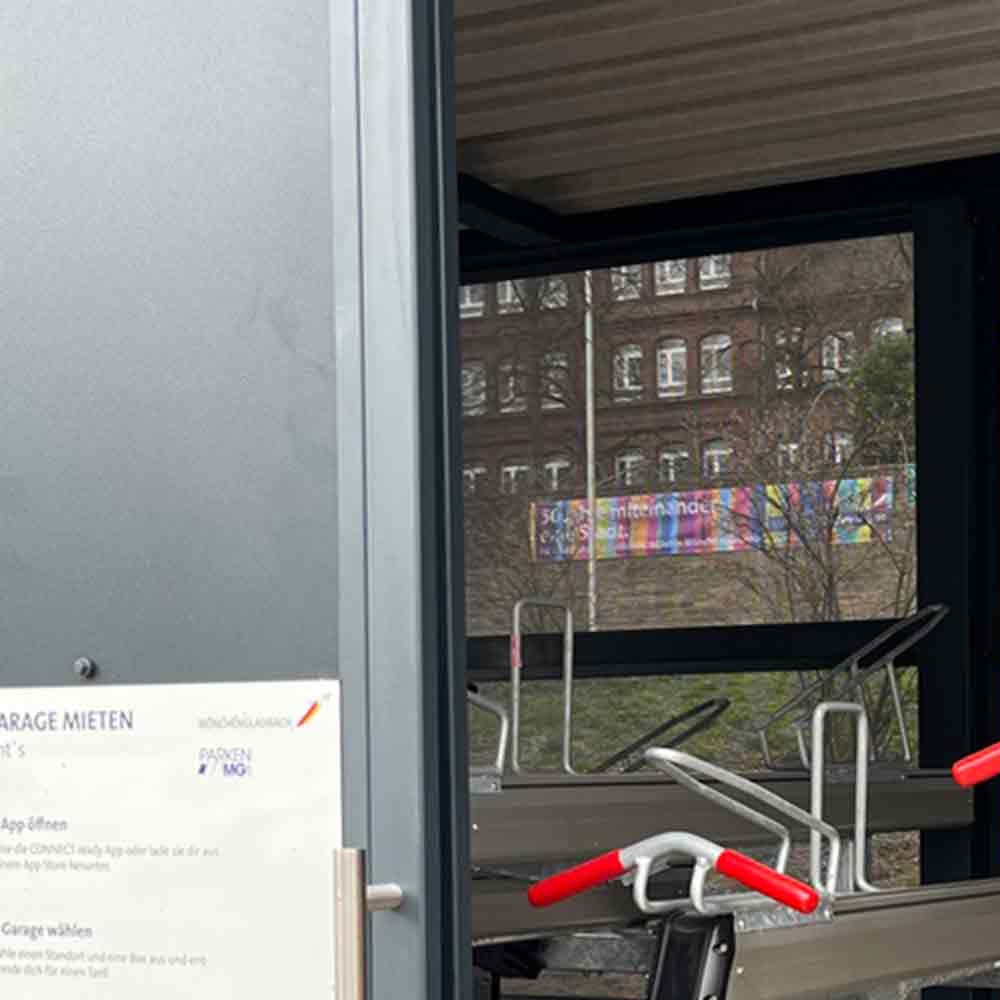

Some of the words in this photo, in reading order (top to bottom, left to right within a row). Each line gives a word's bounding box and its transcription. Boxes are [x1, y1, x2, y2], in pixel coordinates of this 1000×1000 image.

[63, 710, 134, 731] MIETEN
[1, 817, 25, 834] App
[27, 816, 68, 831] öffnen
[1, 921, 44, 941] Garage
[47, 922, 93, 938] wählen
